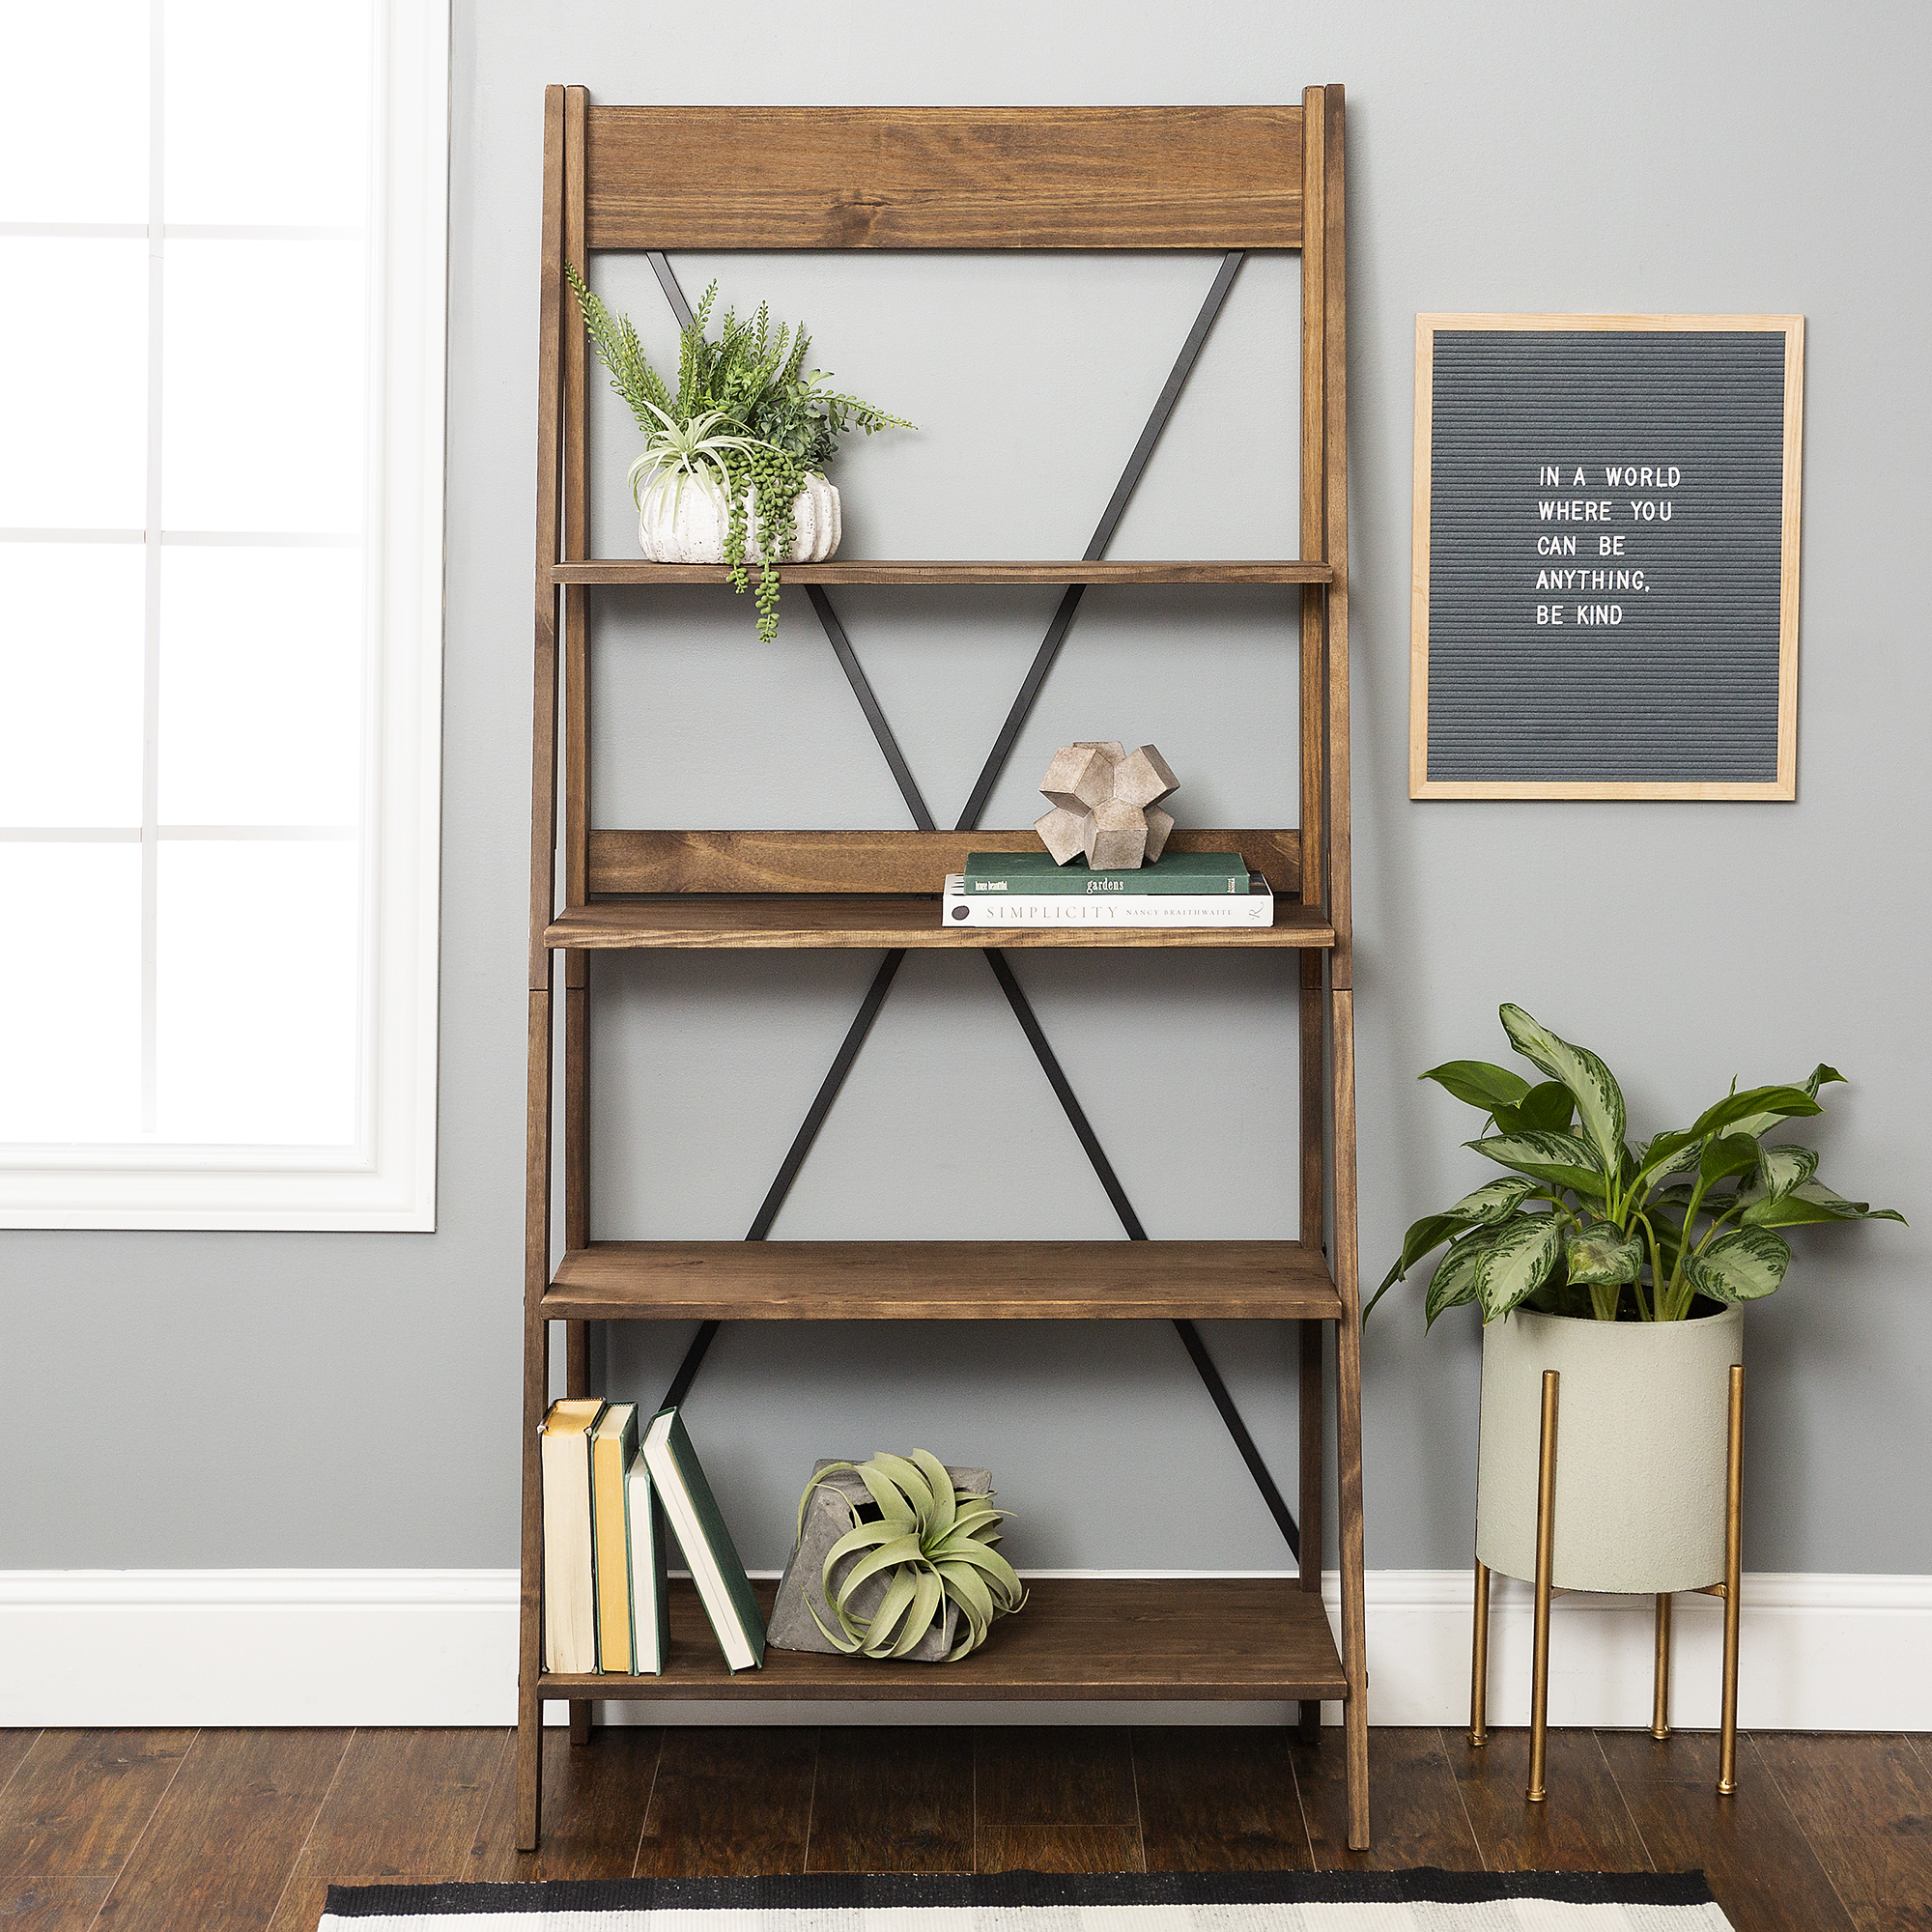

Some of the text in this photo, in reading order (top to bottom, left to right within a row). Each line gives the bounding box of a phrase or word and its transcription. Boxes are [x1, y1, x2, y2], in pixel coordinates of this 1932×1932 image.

[1539, 466, 1681, 488] IN A WORLD
[1538, 500, 1672, 522] WHERE YOU
[1537, 535, 1626, 556] CAN BE
[1535, 569, 1651, 592] ANYTHING,
[1536, 605, 1623, 626] BE KIND
[1086, 877, 1124, 895] gardens
[986, 906, 1118, 919] SIMPLICITY
